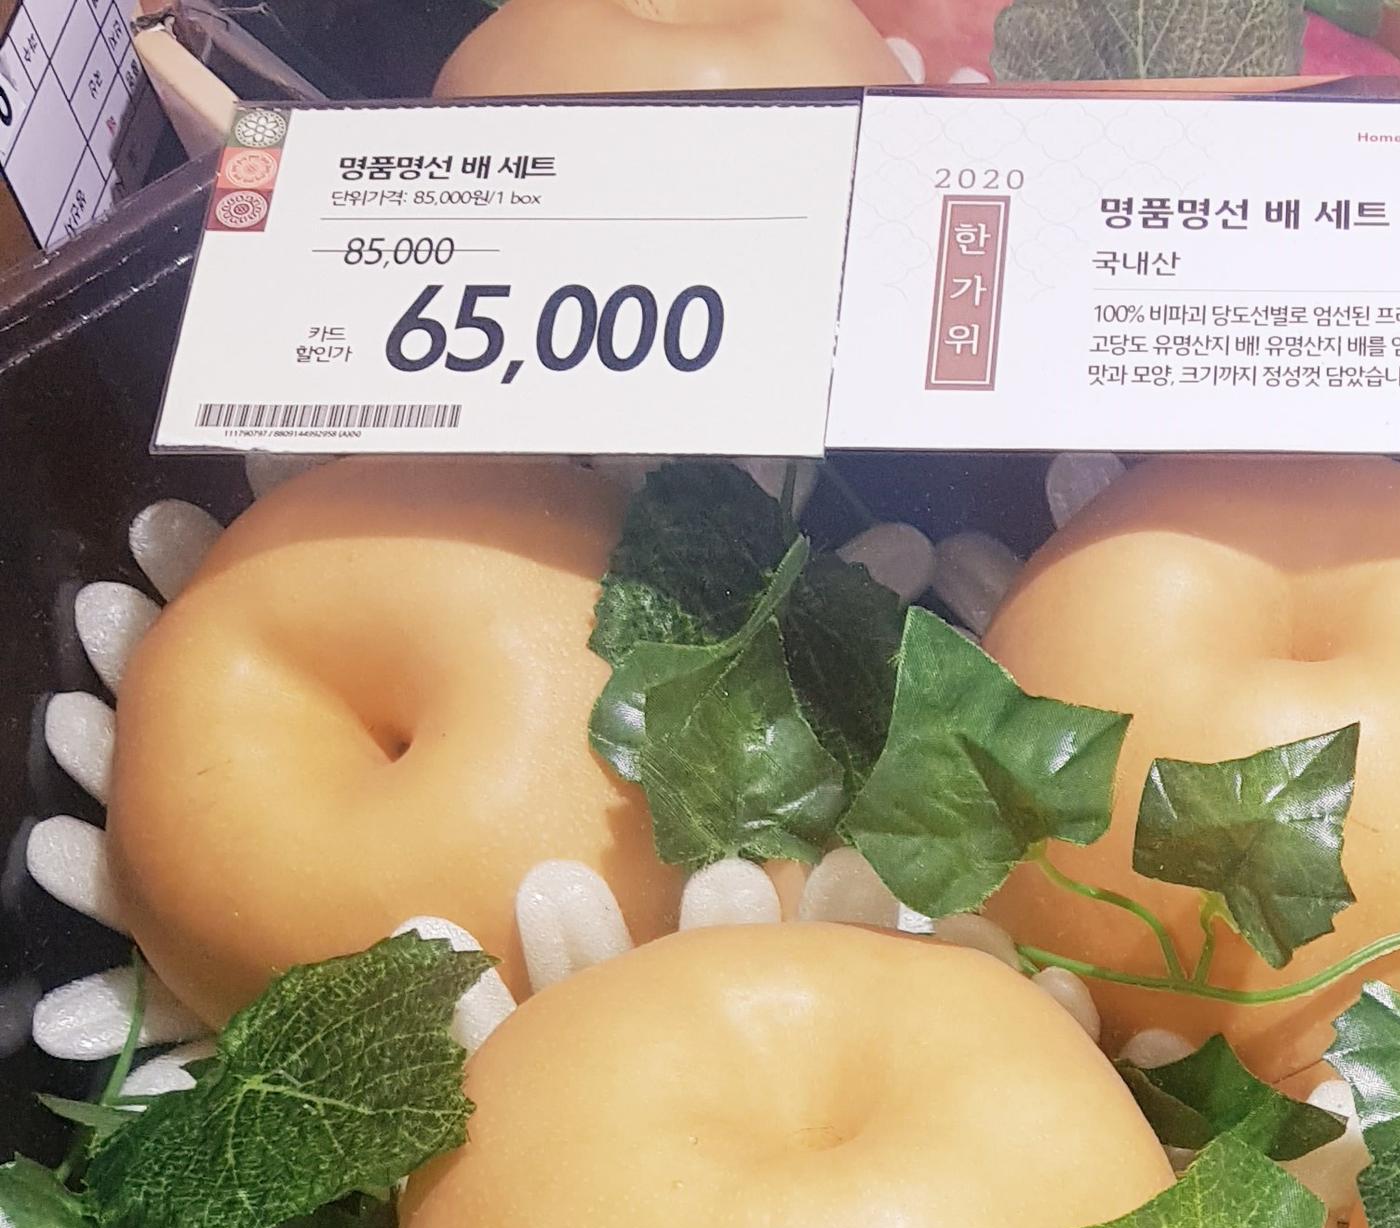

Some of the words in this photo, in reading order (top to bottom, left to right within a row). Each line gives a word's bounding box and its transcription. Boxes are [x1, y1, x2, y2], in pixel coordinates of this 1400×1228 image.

[339, 155, 453, 181] 명품명선
[461, 155, 492, 179] 배
[497, 155, 557, 179] 세트
[934, 168, 1024, 189] 2020
[332, 190, 408, 206] 단위가격:
[510, 191, 541, 204] box
[1101, 197, 1248, 230] 명품명선
[1265, 199, 1300, 230] 배
[1314, 200, 1390, 230] 세트
[344, 237, 456, 269] 85,000
[1092, 251, 1181, 276] 국내산
[944, 223, 991, 356] 한가위
[1094, 305, 1145, 323] 100%
[1150, 304, 1206, 326] 비파괴
[1212, 305, 1308, 327] 당도선별로
[1313, 305, 1370, 327] 엄선된
[308, 326, 346, 342] 카드
[385, 284, 724, 384] 65,000
[1089, 334, 1148, 356] 고당도
[1153, 335, 1229, 356] 유명산지
[1235, 336, 1260, 356] 배!
[1265, 336, 1341, 357] 유명산지
[1348, 336, 1387, 357] 배를
[296, 345, 353, 363] 할인가
[1088, 364, 1128, 385] 맛과
[1131, 365, 1174, 386] 모양,
[1179, 365, 1256, 386] 크기까지
[1263, 366, 1320, 387] 정성껏
